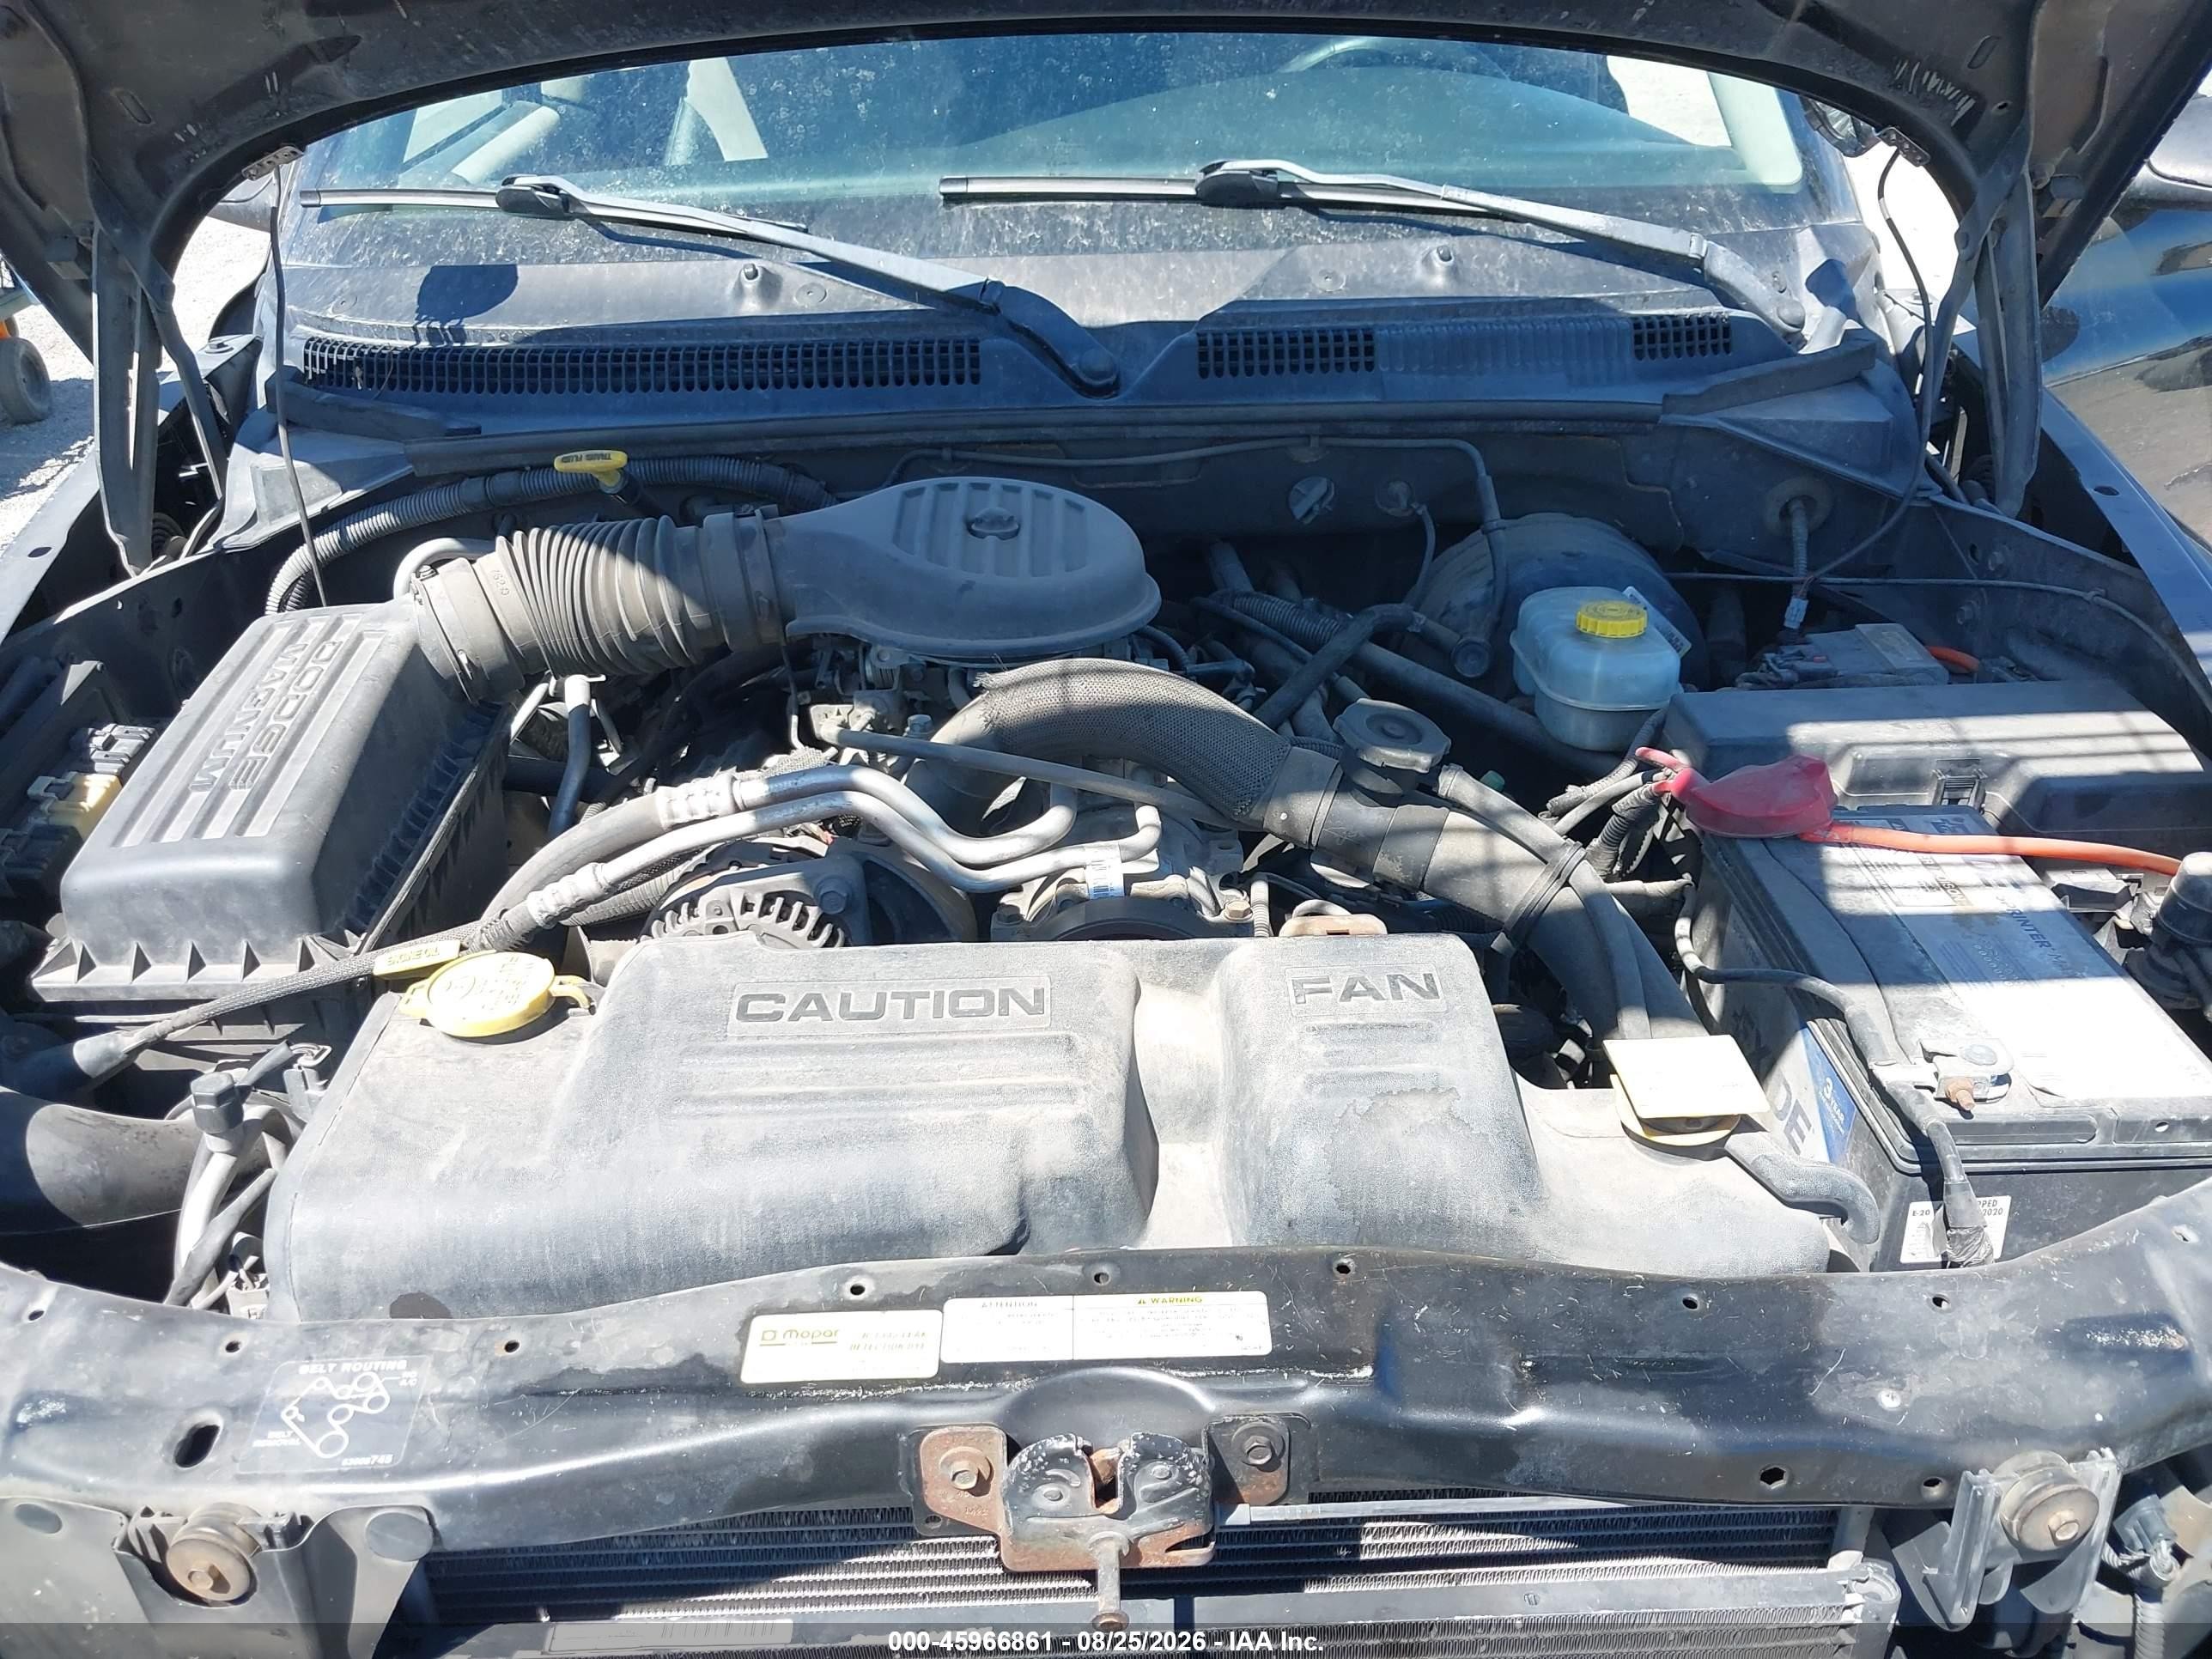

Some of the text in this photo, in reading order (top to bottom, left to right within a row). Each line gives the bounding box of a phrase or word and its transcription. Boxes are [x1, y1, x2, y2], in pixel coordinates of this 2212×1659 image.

[188, 643, 308, 791] MAGNUM
[228, 640, 343, 790] DODGE
[1291, 973, 1440, 1005] FAN
[736, 988, 1045, 1023] CAUTION
[1823, 1077, 1833, 1100] 3
[1151, 1296, 1203, 1304] WARNING
[782, 1328, 839, 1340] mopar
[299, 1360, 408, 1374] BELT ROUTING
